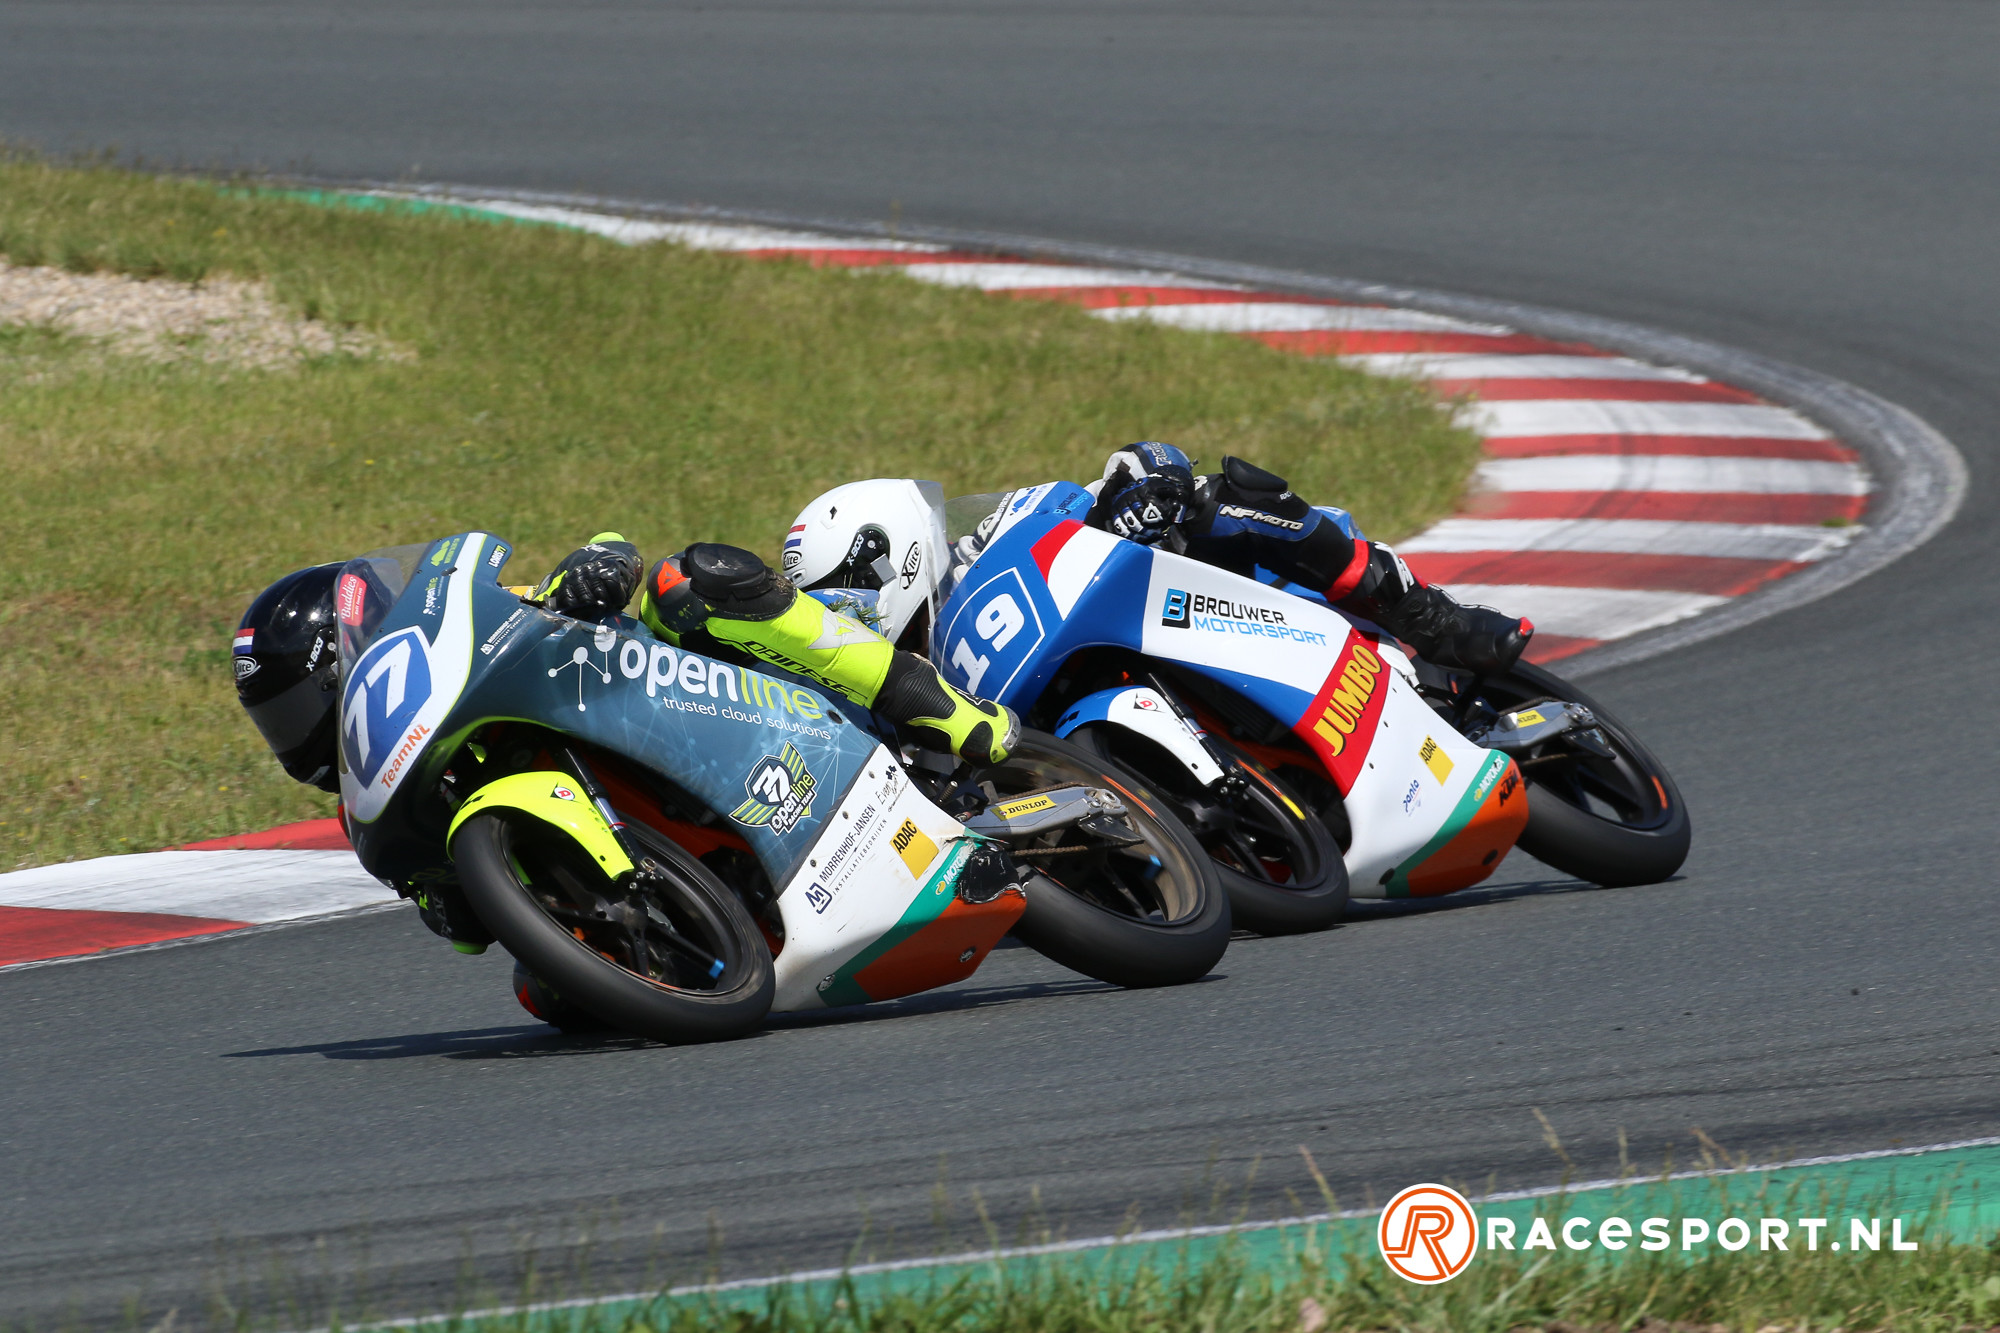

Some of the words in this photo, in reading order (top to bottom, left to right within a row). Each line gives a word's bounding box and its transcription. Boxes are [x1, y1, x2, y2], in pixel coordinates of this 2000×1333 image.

[901, 545, 920, 590] X-lite
[341, 576, 357, 619] Buddies
[1193, 594, 1288, 625] BROUWER
[952, 593, 1025, 696] 19
[1193, 615, 1327, 646] MOTORSPORT
[619, 639, 823, 721] openline
[1312, 644, 1383, 757] JUMBO
[345, 639, 411, 769] 77
[663, 696, 717, 716] trusted
[721, 704, 762, 725] cloud
[767, 715, 831, 740] solutions
[381, 723, 430, 789] TeamNL
[1420, 737, 1437, 765] ADAC
[1008, 799, 1048, 814] DUNLOP
[1498, 768, 1519, 808] KTM
[819, 803, 876, 883] MORRENHOF-JANSEN
[892, 820, 918, 855] ADAC
